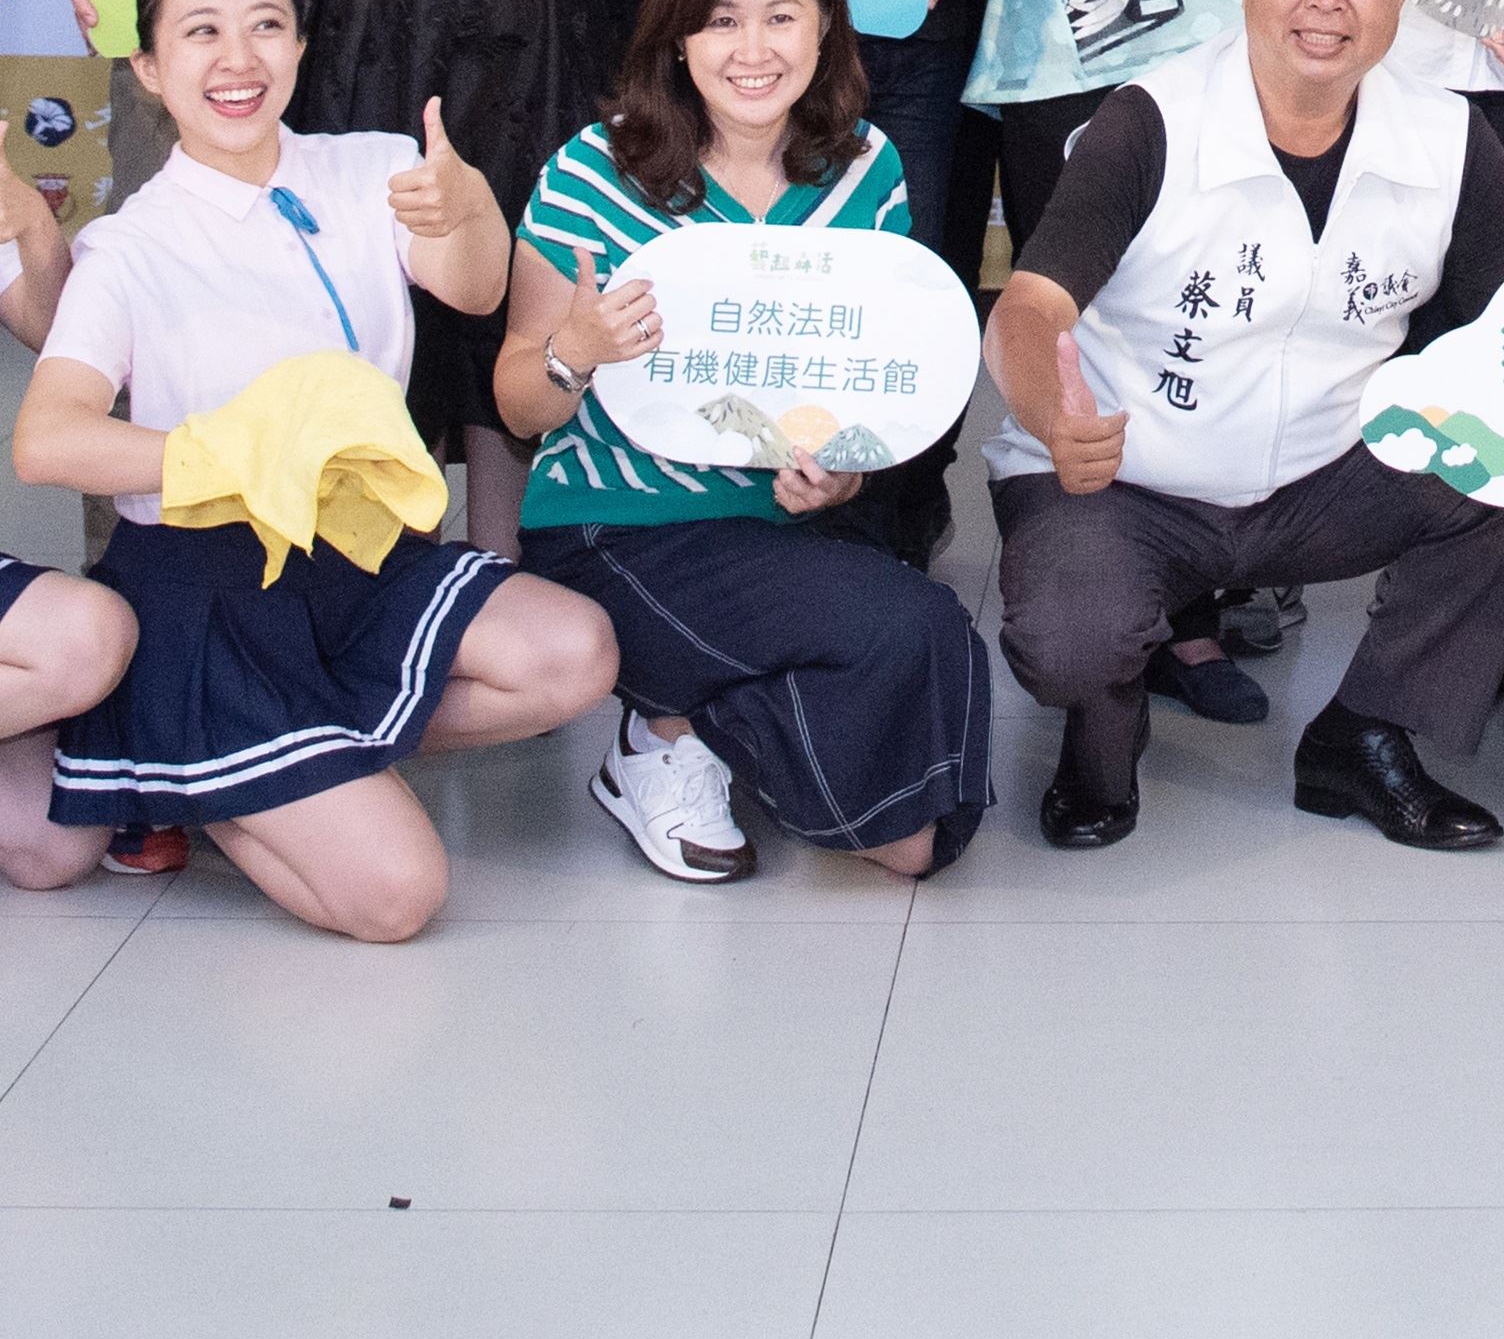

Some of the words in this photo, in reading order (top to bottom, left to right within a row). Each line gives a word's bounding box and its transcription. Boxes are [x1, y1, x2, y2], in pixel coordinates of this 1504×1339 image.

[1232, 243, 1265, 323] 議員
[709, 297, 864, 340] 自然法則
[1152, 270, 1221, 411] 蔡文旭
[643, 346, 919, 395] 有機健康生活館
